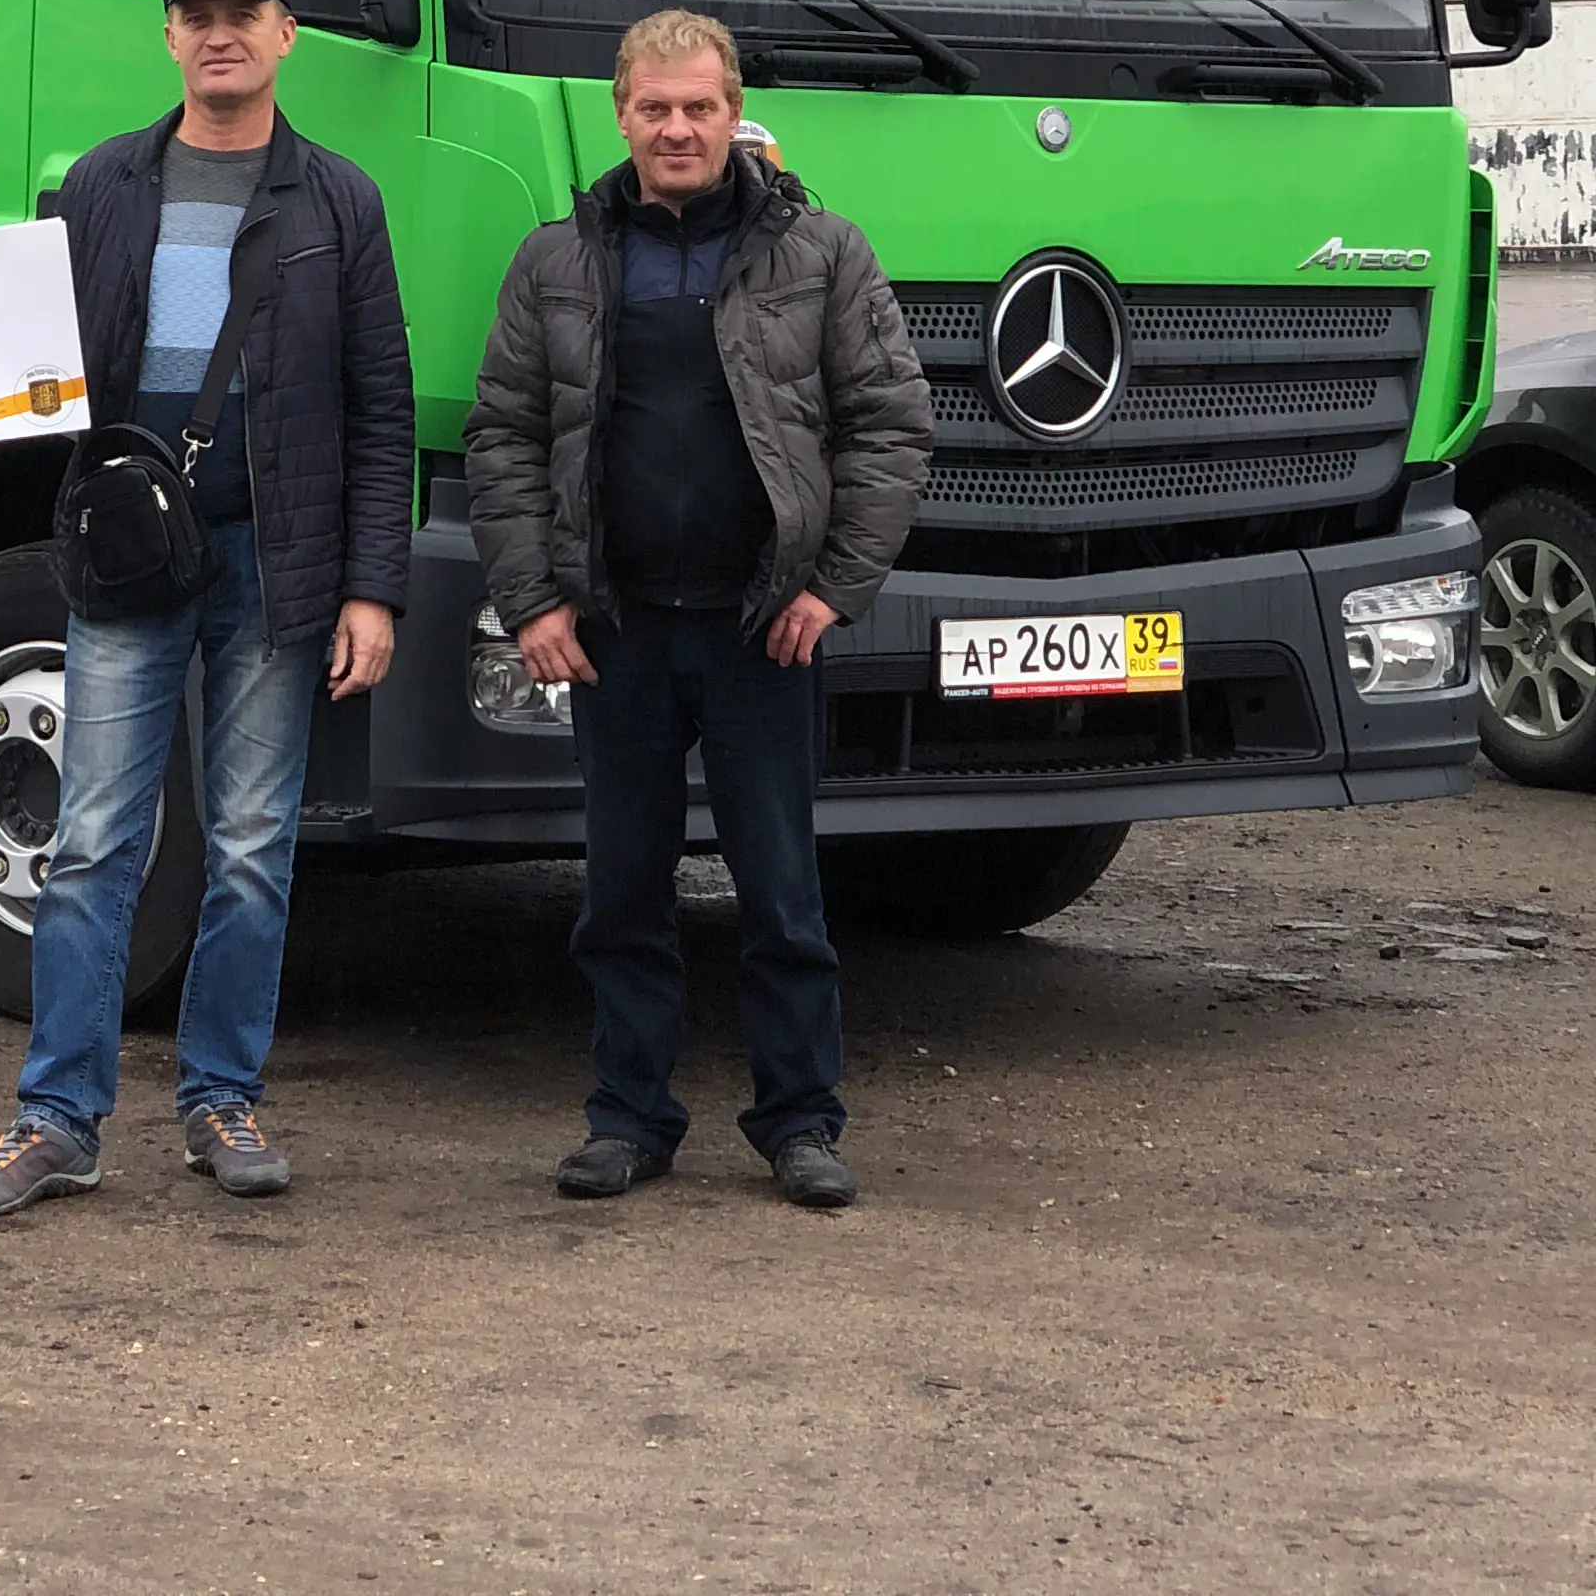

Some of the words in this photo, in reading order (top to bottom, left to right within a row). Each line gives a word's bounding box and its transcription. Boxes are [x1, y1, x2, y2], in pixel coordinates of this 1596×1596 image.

[1295, 237, 1432, 271] ATEGO
[1133, 617, 1169, 654] 39
[1129, 657, 1156, 672] RUS
